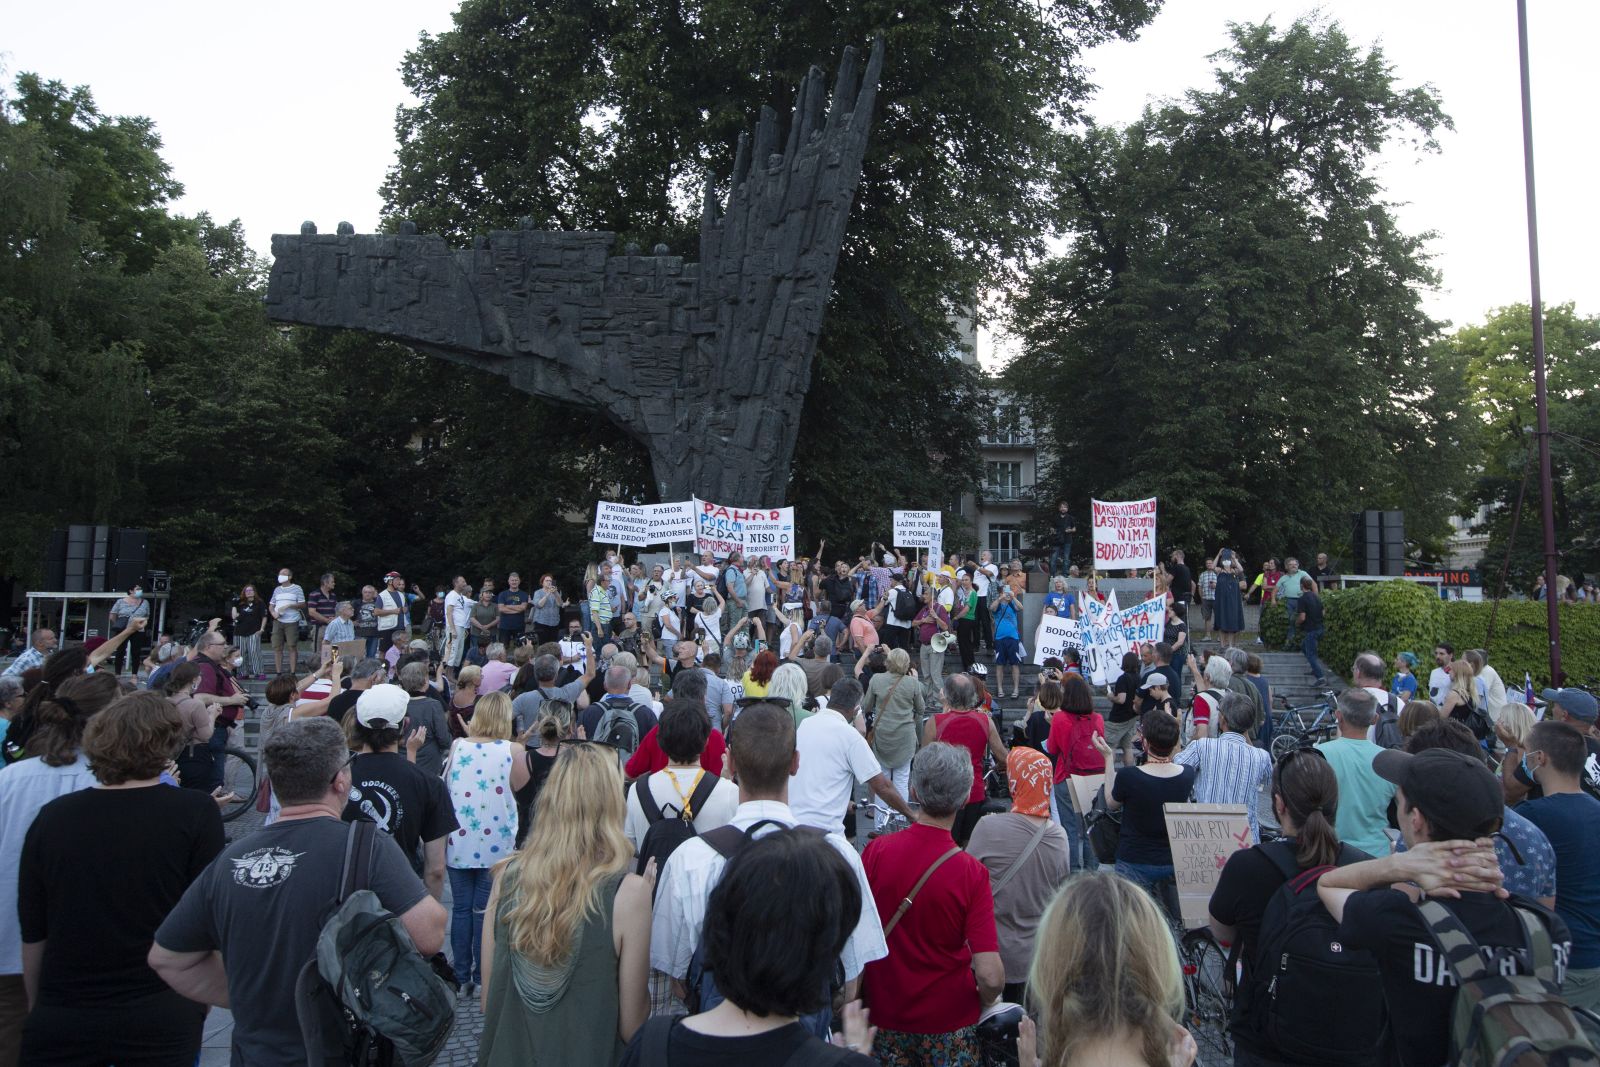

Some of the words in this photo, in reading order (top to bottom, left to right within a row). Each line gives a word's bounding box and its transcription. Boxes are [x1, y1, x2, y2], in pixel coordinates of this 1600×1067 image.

[605, 504, 644, 516] PRIMORCI
[653, 506, 683, 515] PAHOR
[612, 515, 648, 525] POZABIMO
[648, 517, 693, 527] ZDAJALEC
[896, 520, 916, 528] LAŽNI
[917, 521, 939, 529] FOJBI
[611, 523, 647, 534] MORILCE
[745, 523, 779, 531] ANTIFAŠISTI
[595, 531, 619, 540] NAŠIH
[620, 534, 647, 543] DEDOV
[750, 533, 775, 543] NISO
[1117, 528, 1149, 542] NIMA
[746, 545, 779, 553] TERORISTI
[1045, 625, 1082, 641] BODOČ
[1138, 623, 1159, 641] BITI
[1207, 820, 1230, 840] RTV
[1183, 842, 1210, 855] NOVA
[1213, 842, 1225, 855] 24
